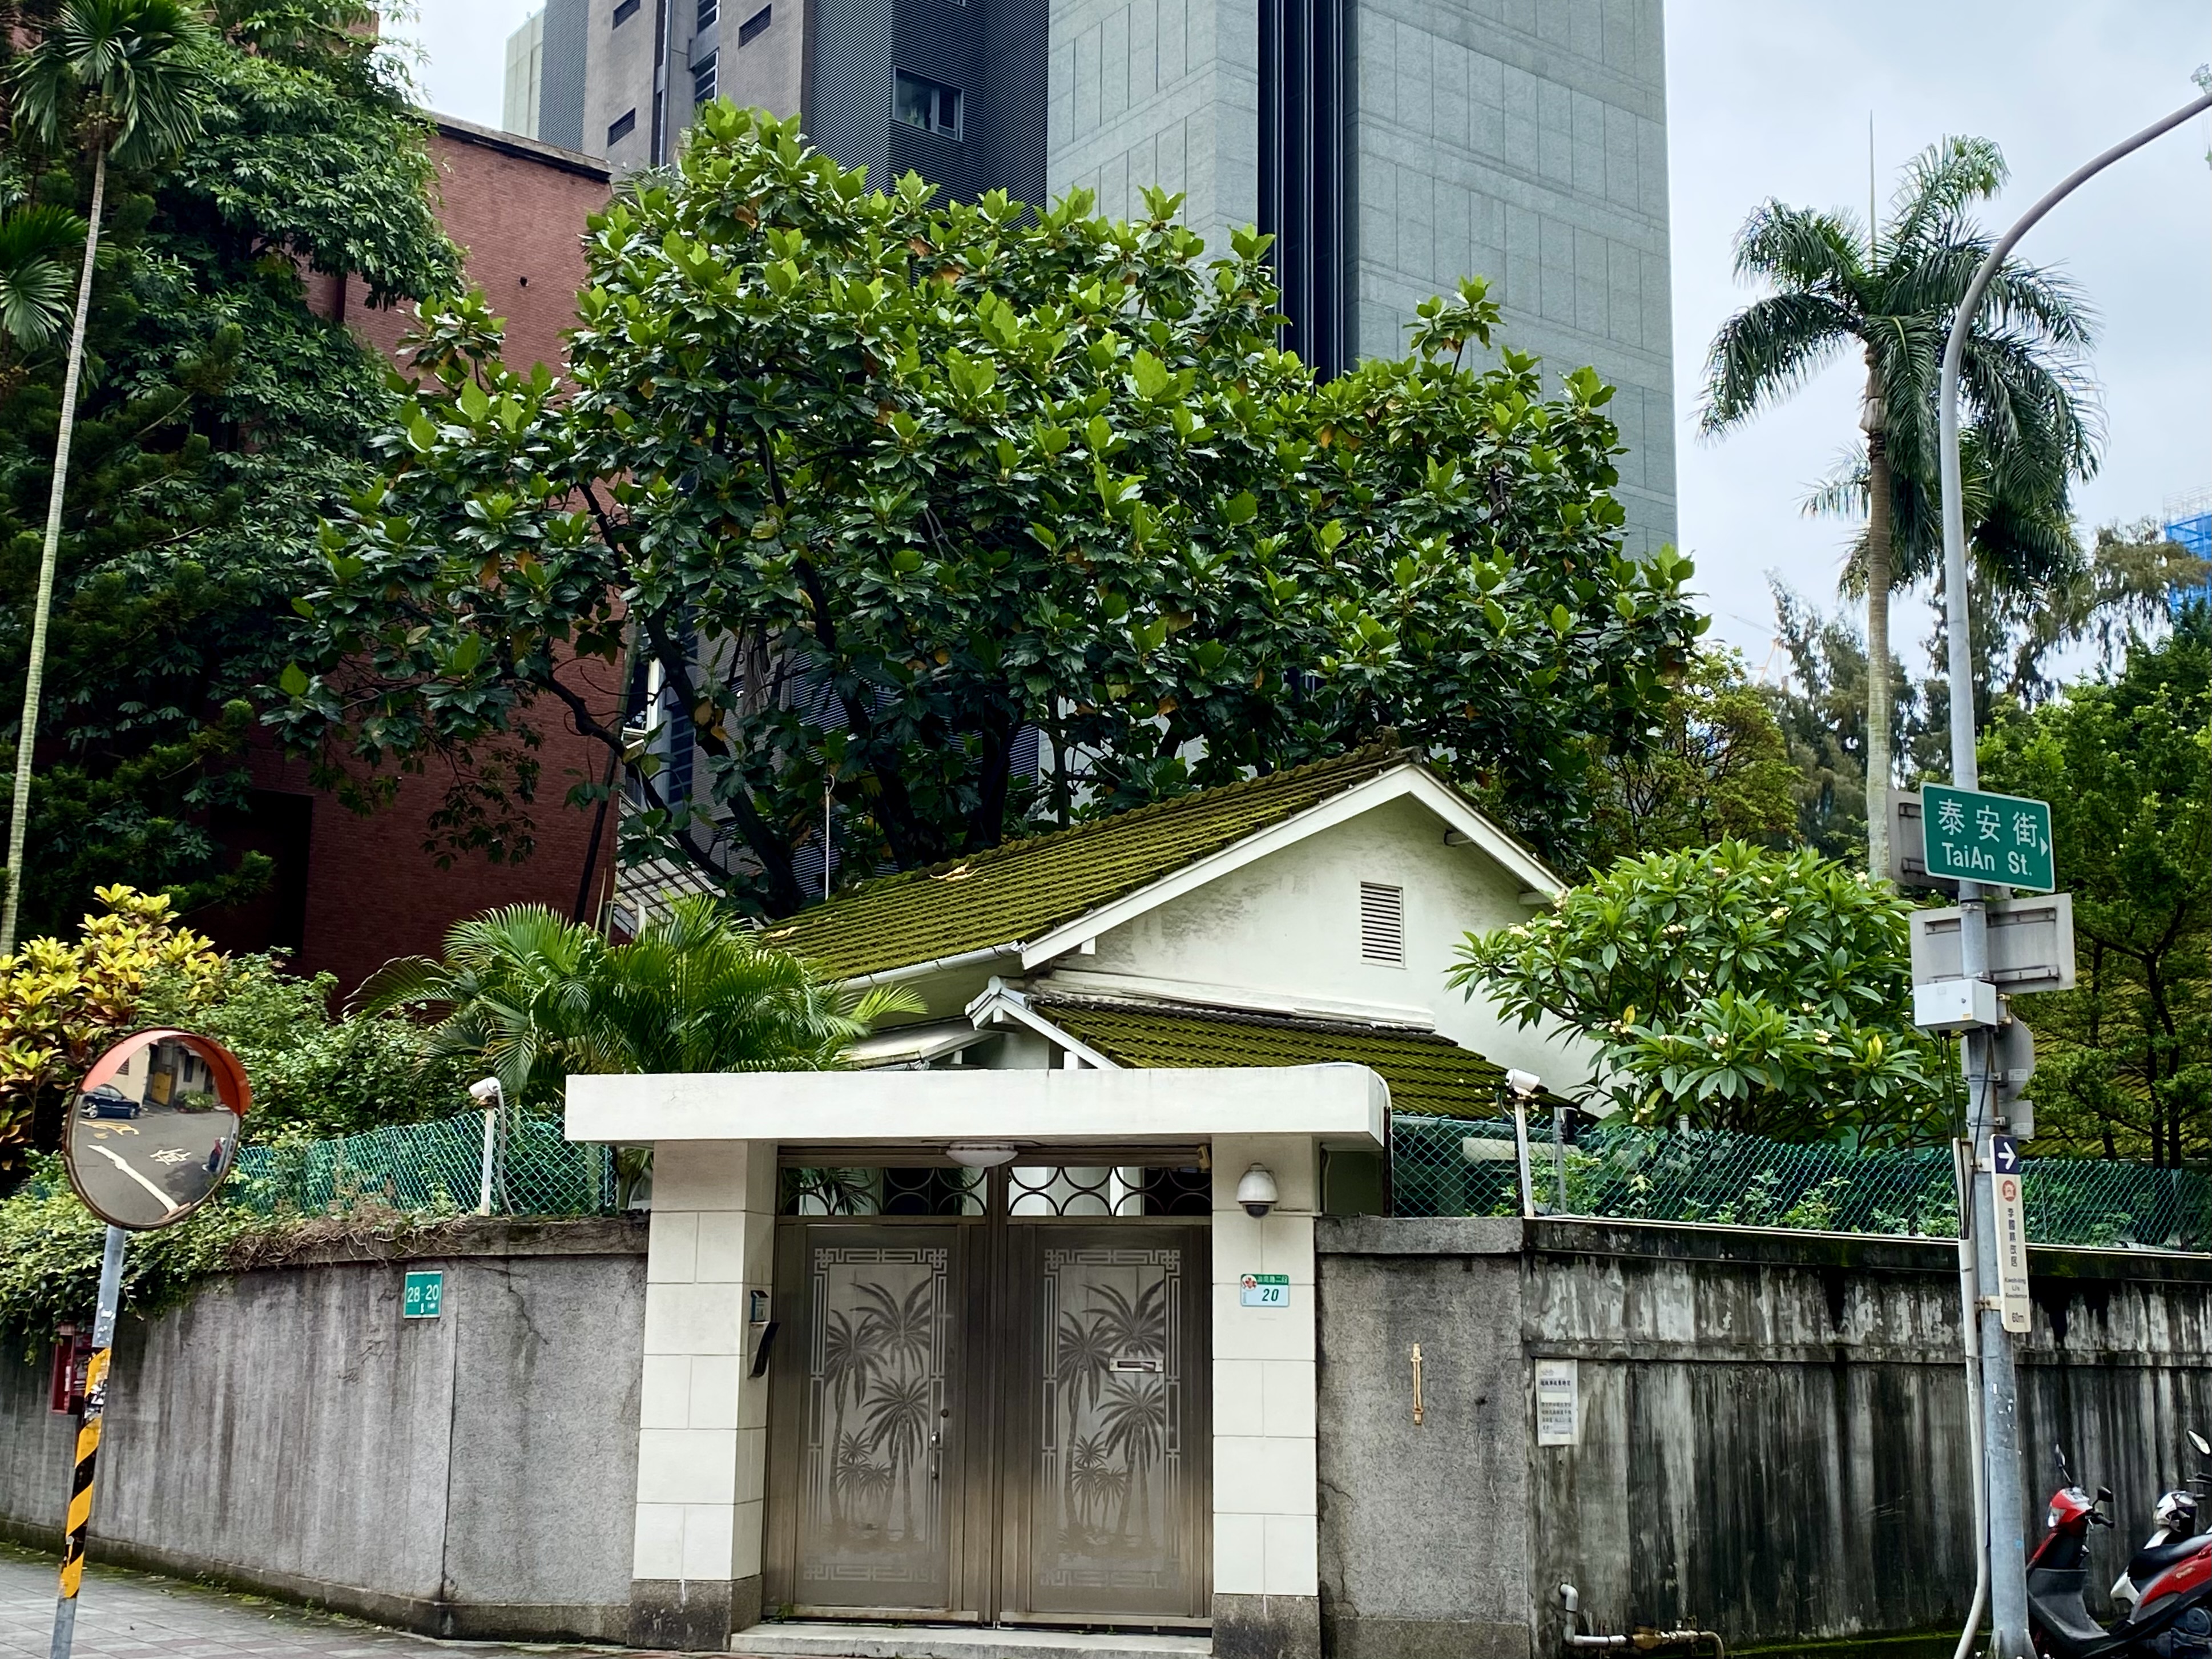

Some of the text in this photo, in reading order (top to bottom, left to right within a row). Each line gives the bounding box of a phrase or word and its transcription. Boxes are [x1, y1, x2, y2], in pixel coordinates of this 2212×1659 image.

[1938, 798, 2037, 848] 泰安街
[1941, 841, 2032, 876] TaiAn St.
[1262, 1288, 1279, 1302] 20
